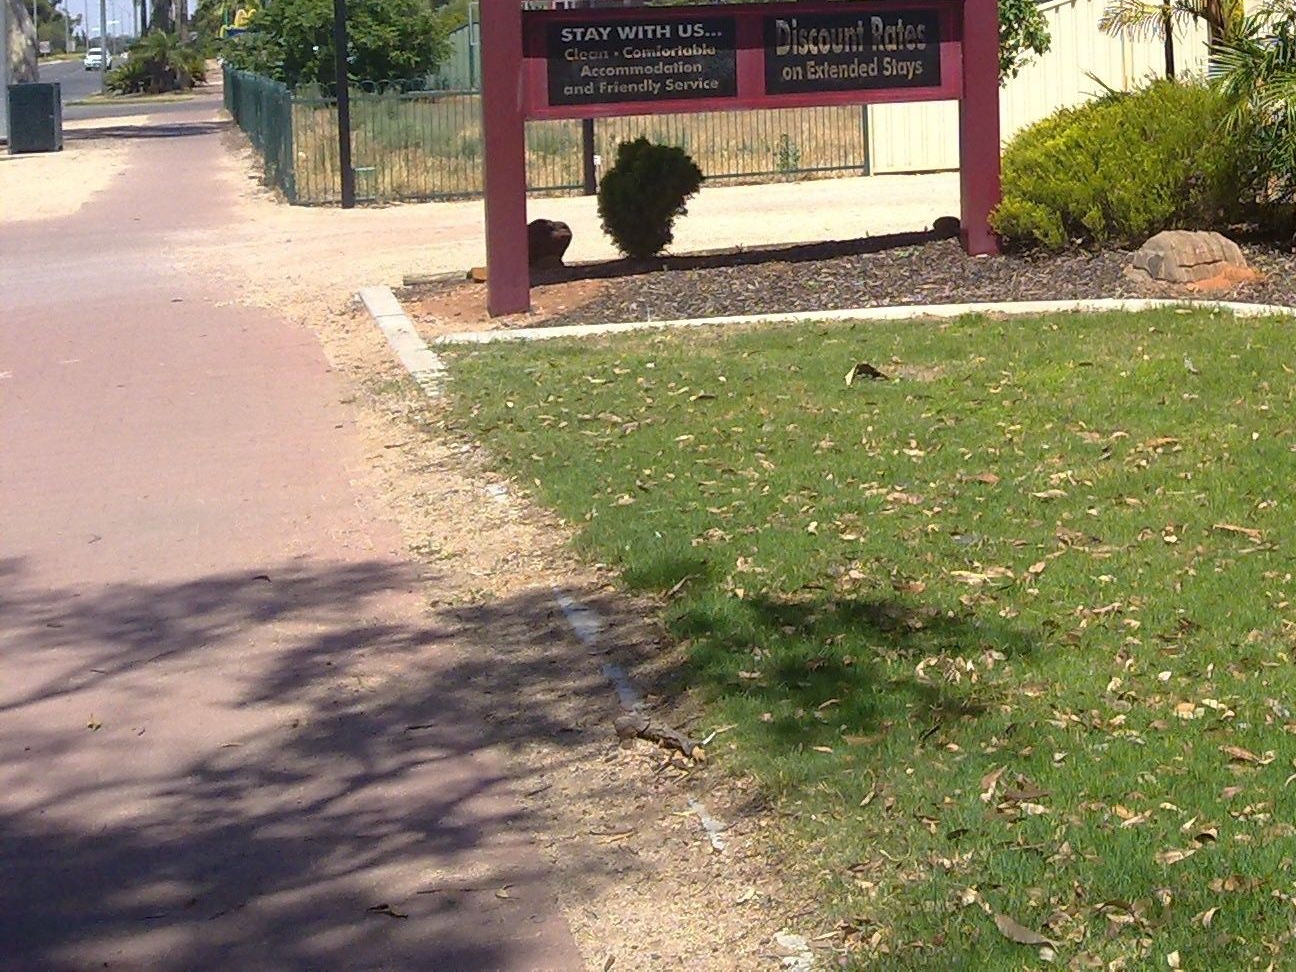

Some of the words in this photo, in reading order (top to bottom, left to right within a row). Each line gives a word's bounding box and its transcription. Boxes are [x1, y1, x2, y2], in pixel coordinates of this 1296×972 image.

[561, 28, 613, 42] STAY
[616, 26, 671, 40] WITH
[775, 17, 865, 56] Discount
[870, 15, 927, 52] Rates
[564, 47, 609, 61] Clean
[622, 43, 716, 59] Comfortable
[580, 62, 703, 77] Accommodation
[782, 65, 803, 81] on
[806, 57, 878, 80] Extended
[882, 56, 924, 79] Stays
[563, 82, 595, 96] and
[599, 79, 661, 95] Friendly
[665, 77, 720, 91] Service
